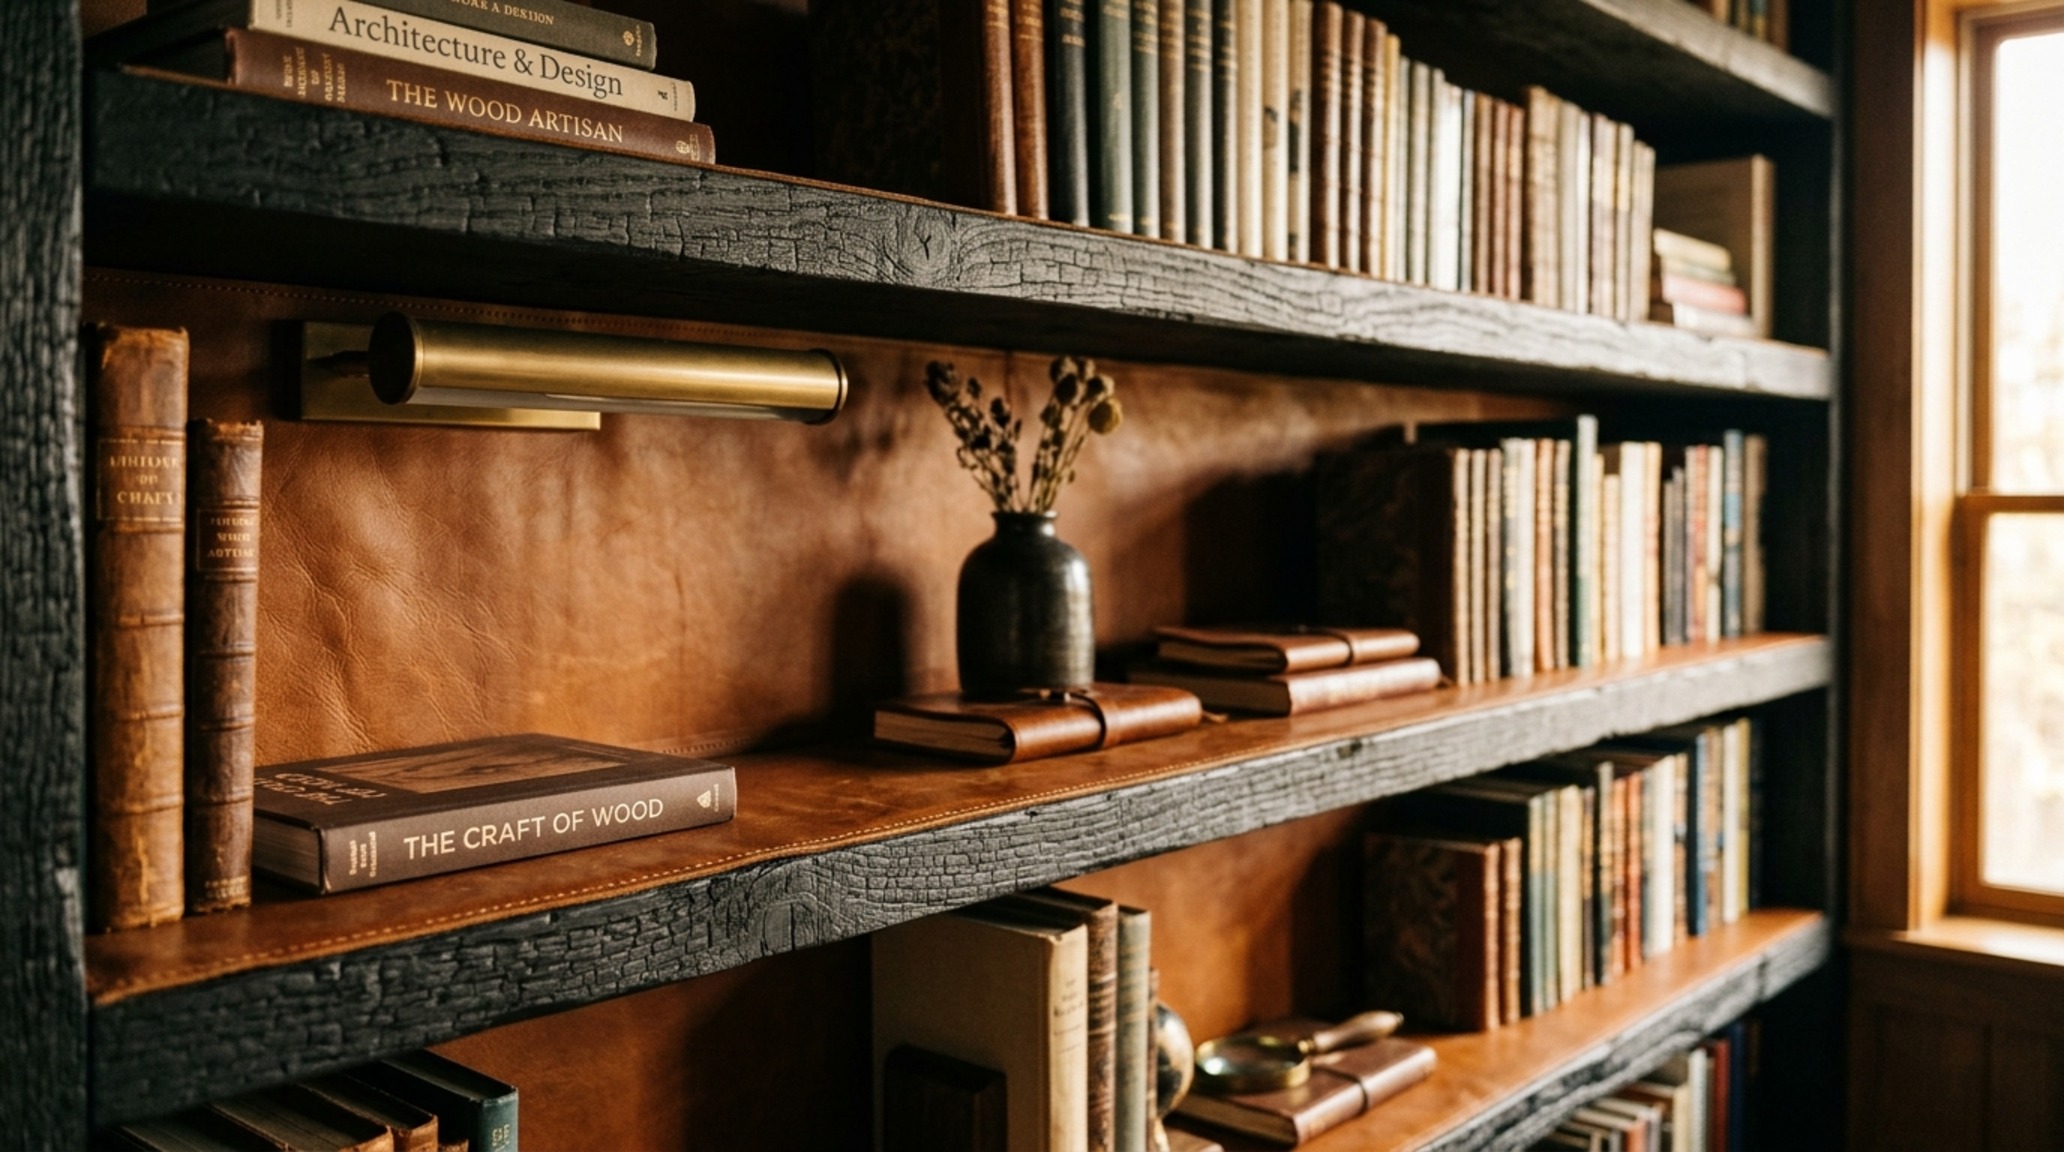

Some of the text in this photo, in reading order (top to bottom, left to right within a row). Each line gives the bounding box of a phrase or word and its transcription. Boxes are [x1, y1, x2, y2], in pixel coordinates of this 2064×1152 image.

[328, 6, 506, 70] Architecture
[514, 48, 533, 76] &
[540, 53, 623, 99] Design
[386, 79, 438, 109] THE
[444, 90, 522, 124] WOOD
[528, 108, 623, 143] ARTISAN
[403, 830, 456, 860] THE
[463, 816, 546, 850] CRAFT
[553, 810, 584, 834] OF
[592, 798, 664, 828] WOOD
